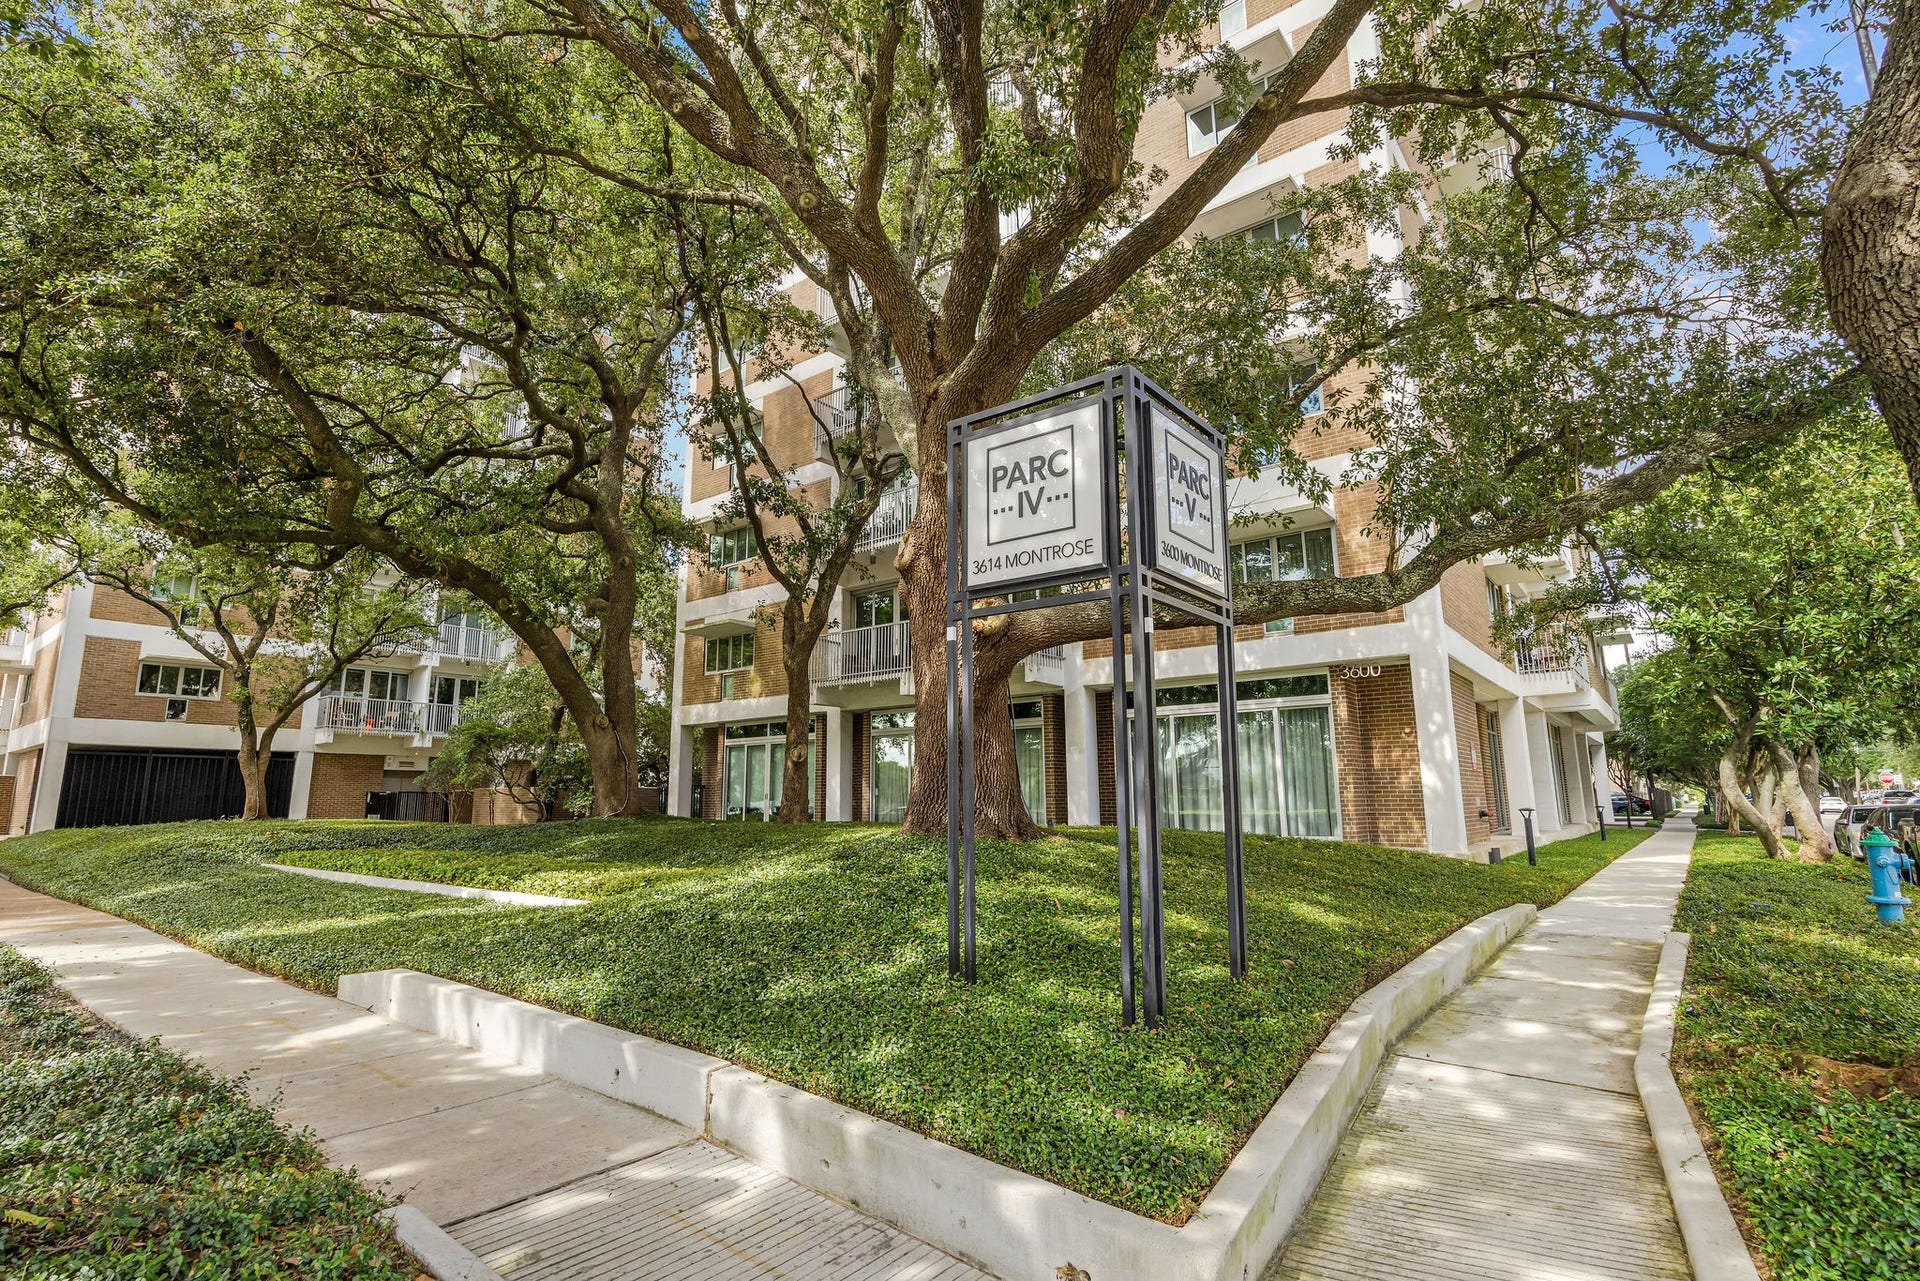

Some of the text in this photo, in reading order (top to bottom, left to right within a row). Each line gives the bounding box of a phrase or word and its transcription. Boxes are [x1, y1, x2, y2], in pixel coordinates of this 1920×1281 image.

[992, 448, 1069, 493] PARC
[1169, 452, 1209, 500] PARC
[1018, 486, 1045, 518] IV
[1184, 492, 1197, 522] V
[972, 538, 1094, 575] 3614 MONTROSE
[1161, 541, 1223, 582] 3600 MONTROSE
[1340, 662, 1381, 679] 3600
